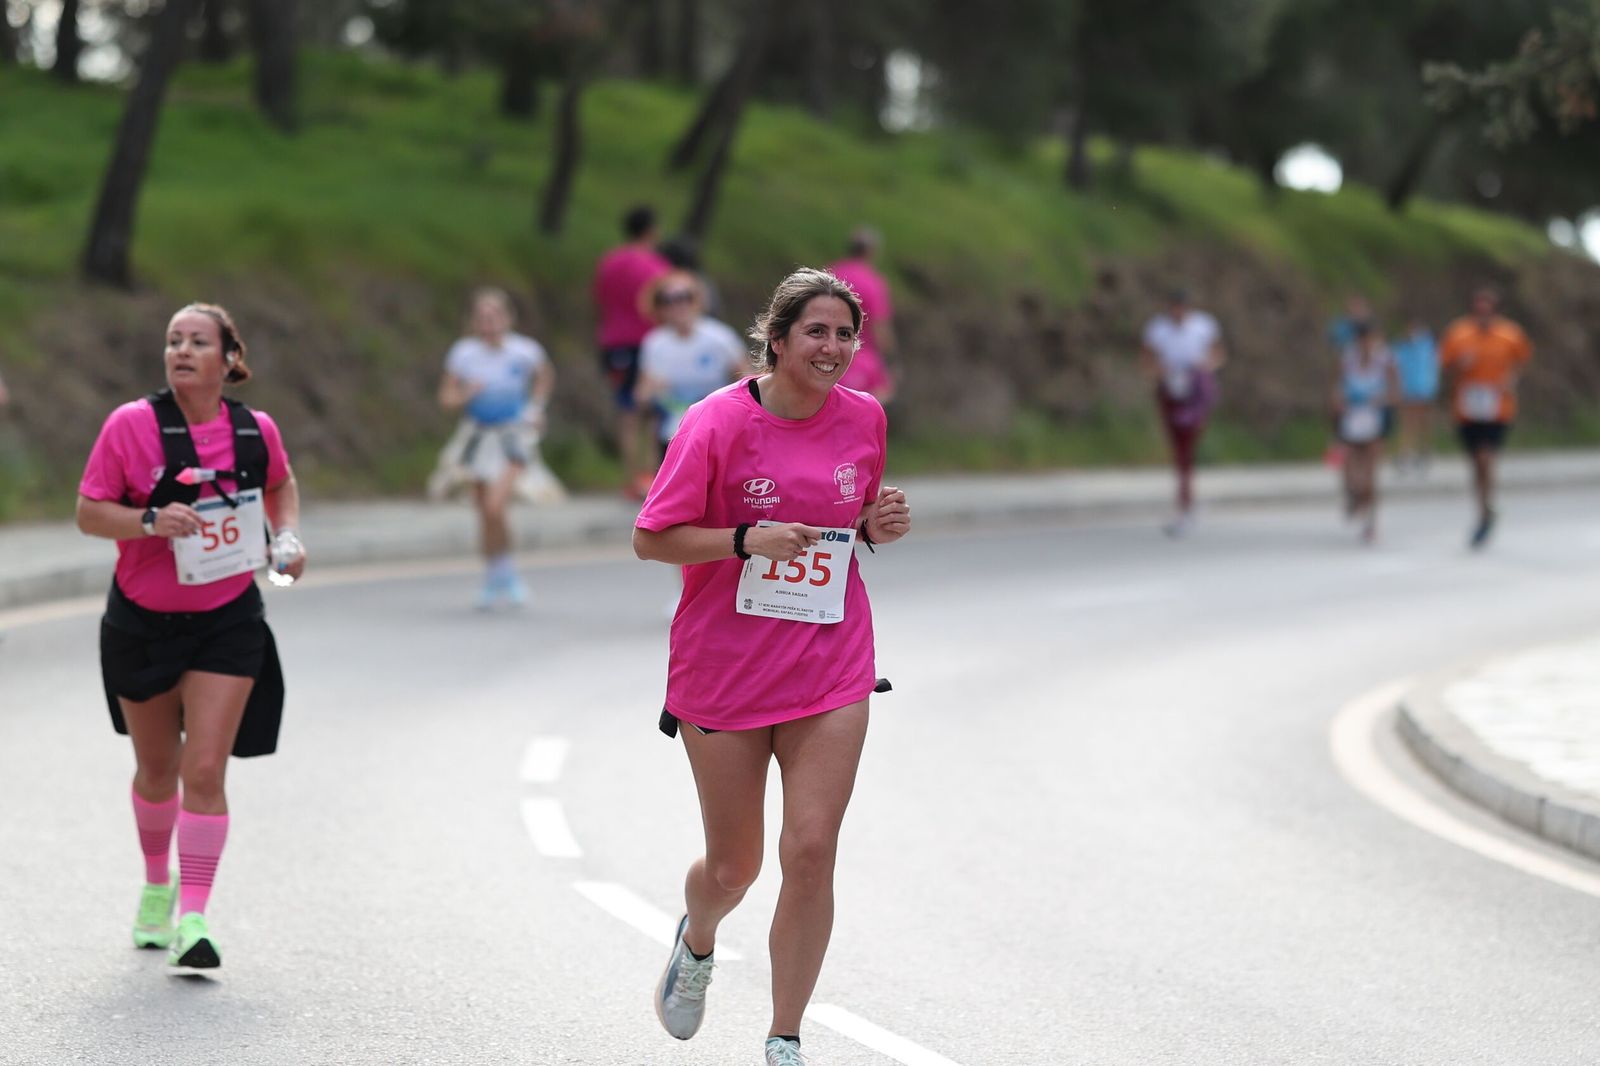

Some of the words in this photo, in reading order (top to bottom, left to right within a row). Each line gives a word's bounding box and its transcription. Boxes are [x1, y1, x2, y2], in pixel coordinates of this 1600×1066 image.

[743, 496, 780, 505] HYUNDAI
[201, 516, 240, 551] 56
[761, 550, 832, 587] 155
